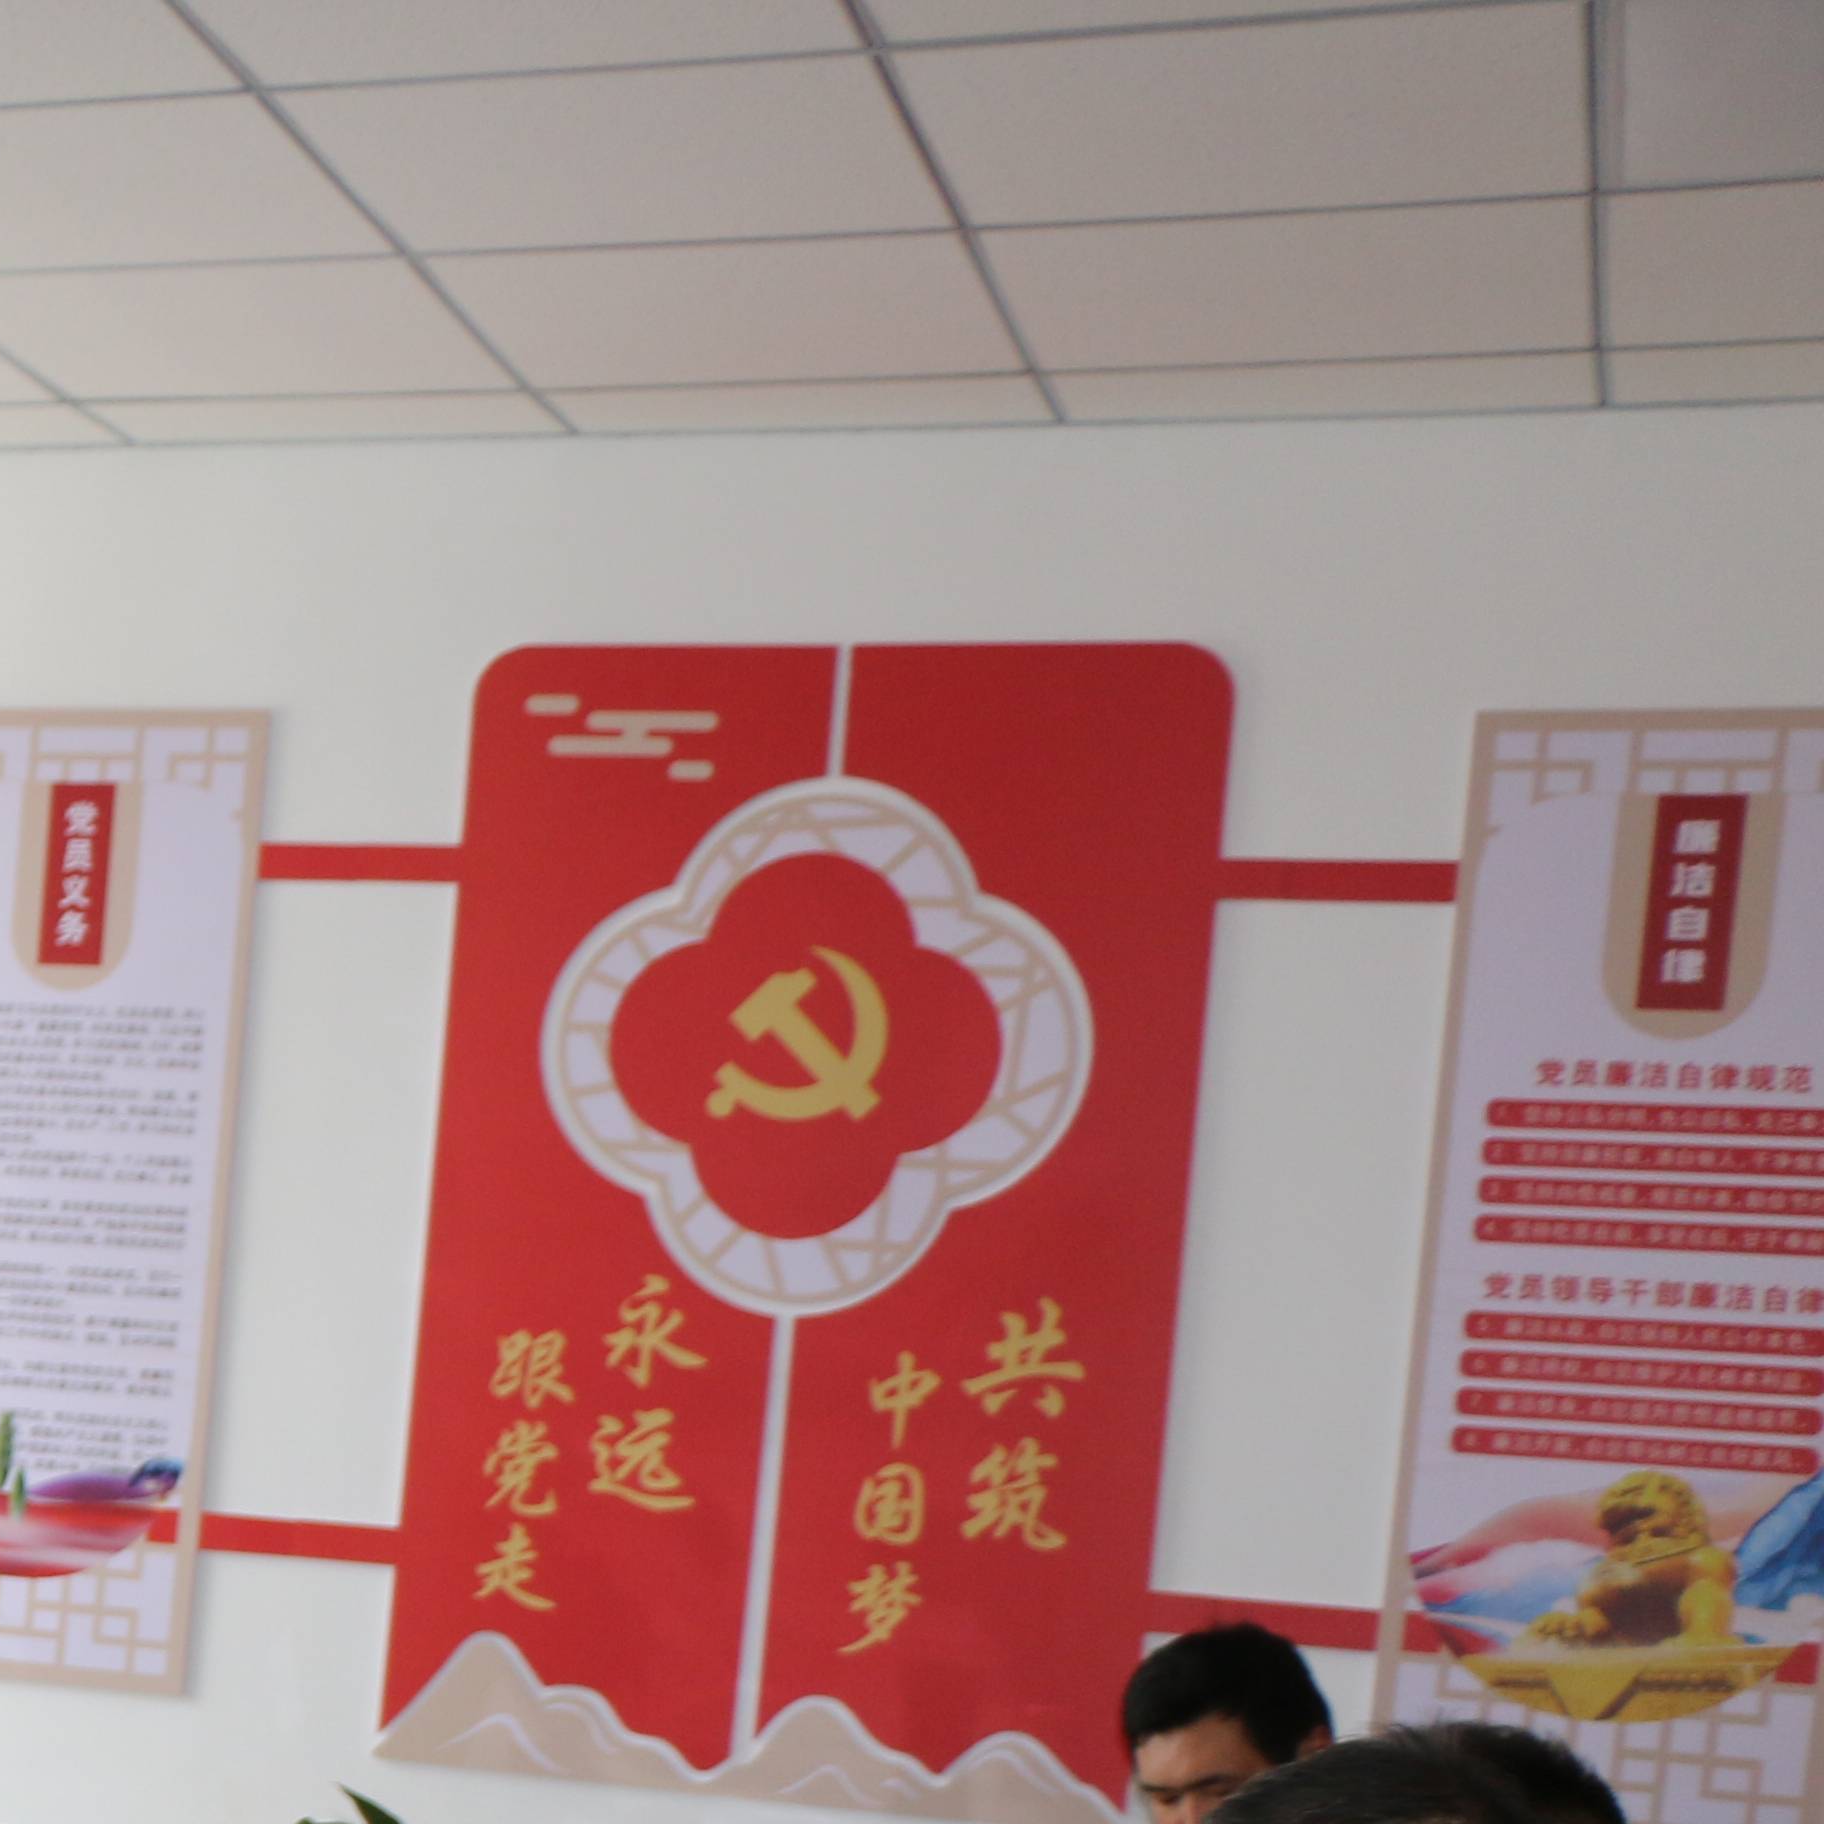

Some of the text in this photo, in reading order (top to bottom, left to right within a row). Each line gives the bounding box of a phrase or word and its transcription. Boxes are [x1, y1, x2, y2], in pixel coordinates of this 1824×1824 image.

[54, 800, 100, 946] 党员义务
[473, 1328, 575, 1612] 跟党走
[588, 1273, 709, 1511] 永远
[836, 1350, 942, 1653] 中国梦
[961, 1296, 1086, 1549] 共筑
